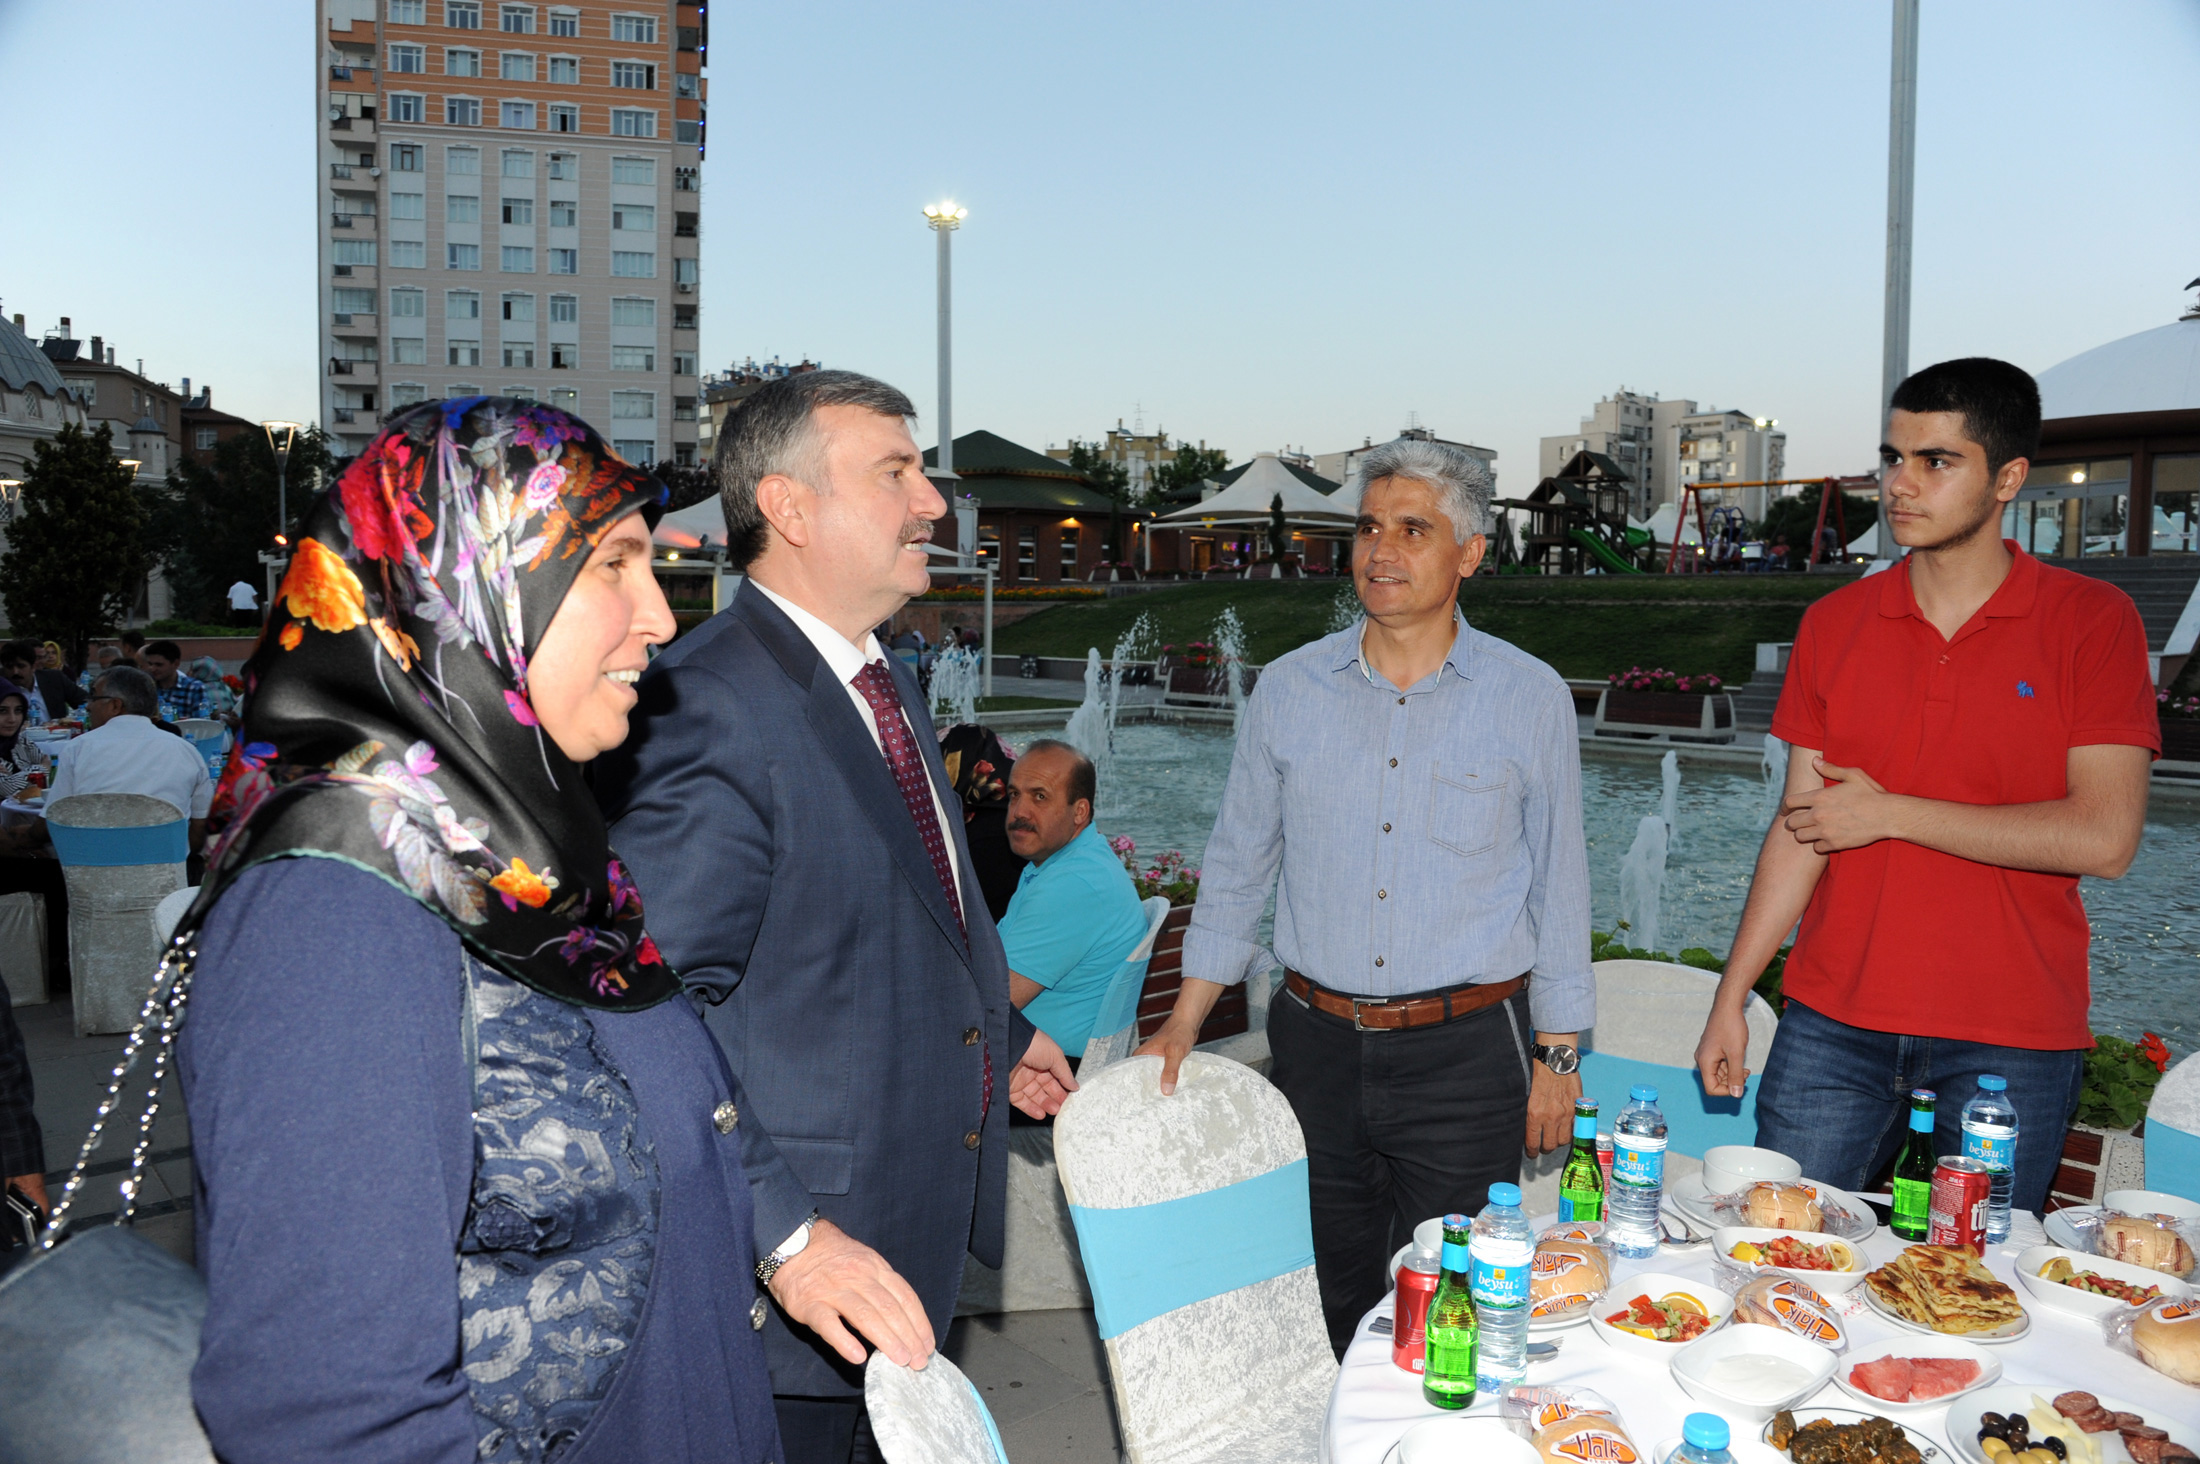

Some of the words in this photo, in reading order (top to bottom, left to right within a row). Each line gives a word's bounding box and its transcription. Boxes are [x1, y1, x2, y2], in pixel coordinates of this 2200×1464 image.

[1969, 1142, 1999, 1158] beysu
[1616, 1154, 1645, 1171] beysu
[1478, 1271, 1514, 1291] beysu
[1785, 1305, 1824, 1340] Halk
[1575, 1432, 1621, 1458] Halk
